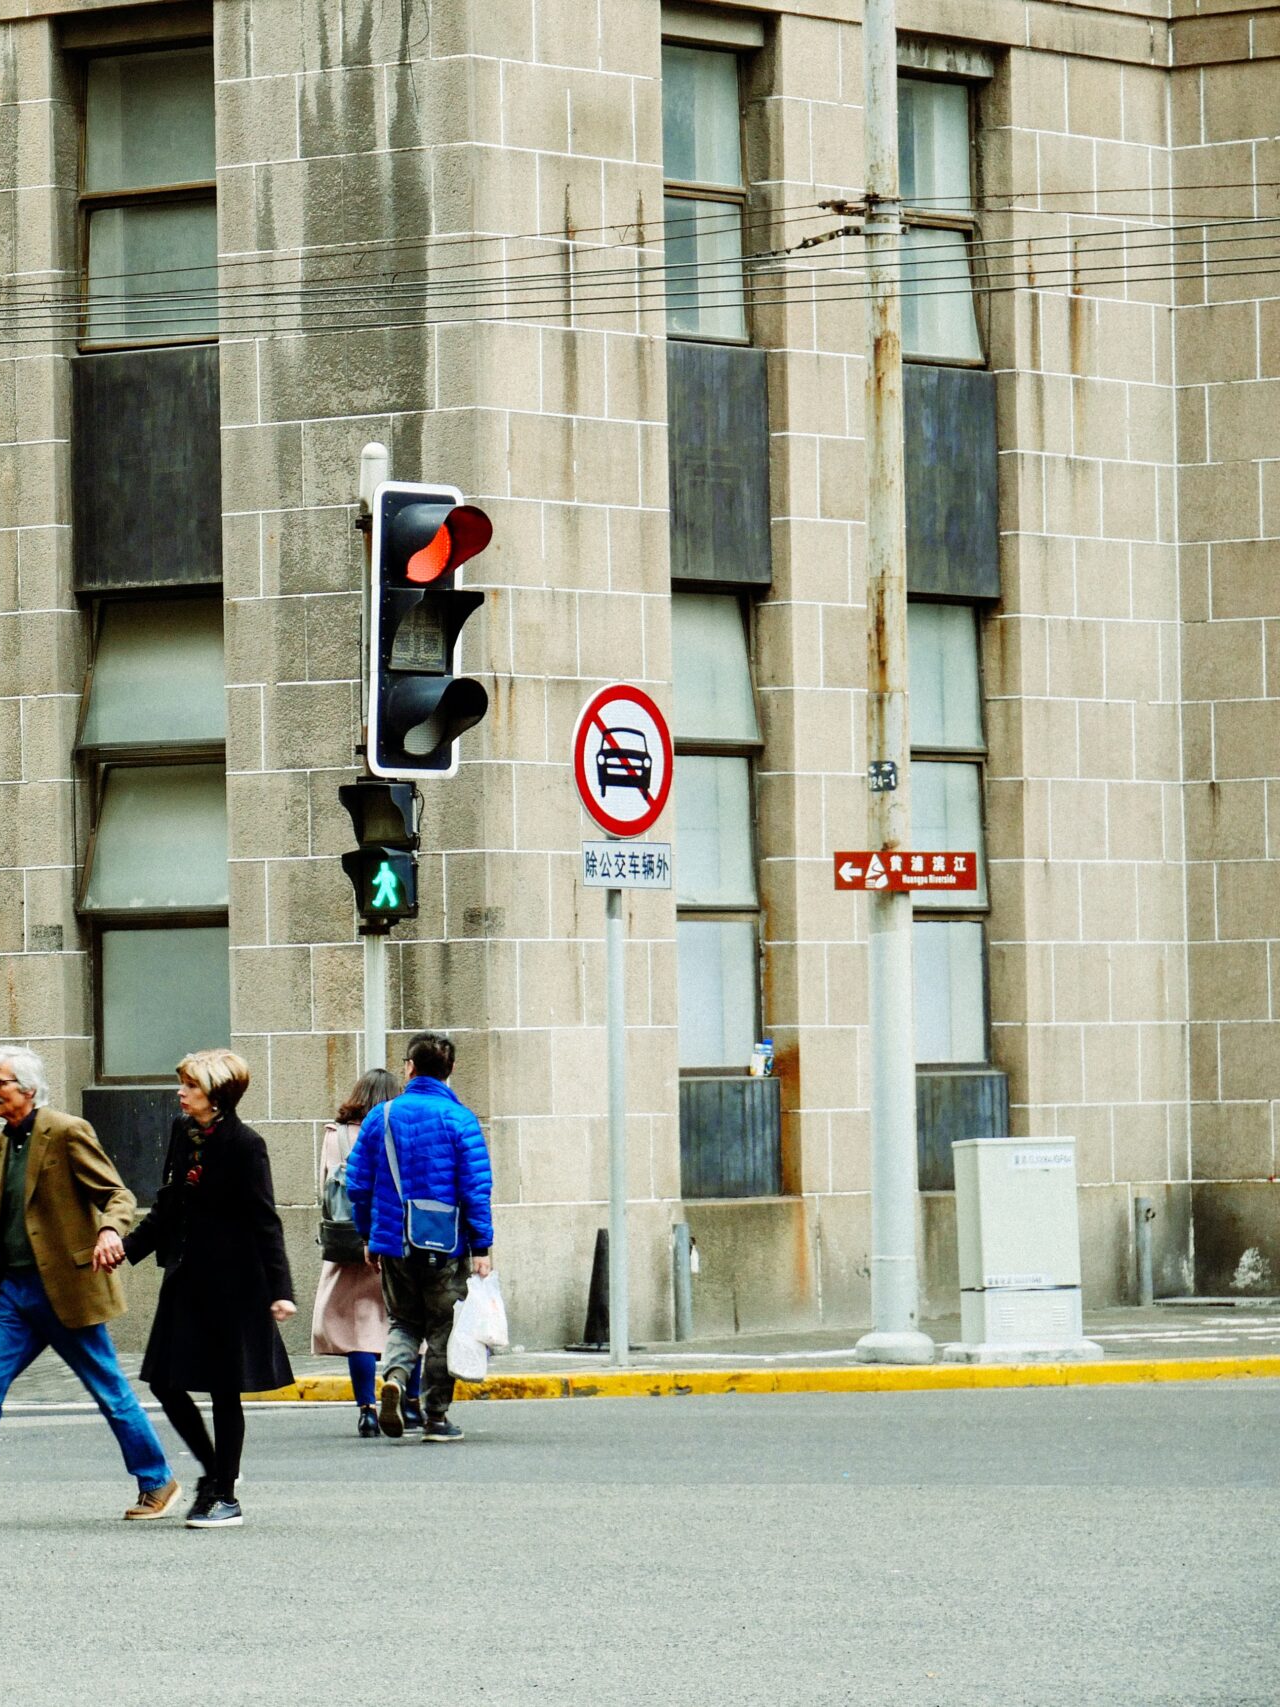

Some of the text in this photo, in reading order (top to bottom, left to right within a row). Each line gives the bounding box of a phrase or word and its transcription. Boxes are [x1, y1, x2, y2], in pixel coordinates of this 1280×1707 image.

[585, 850, 669, 881] 除公交车辆外
